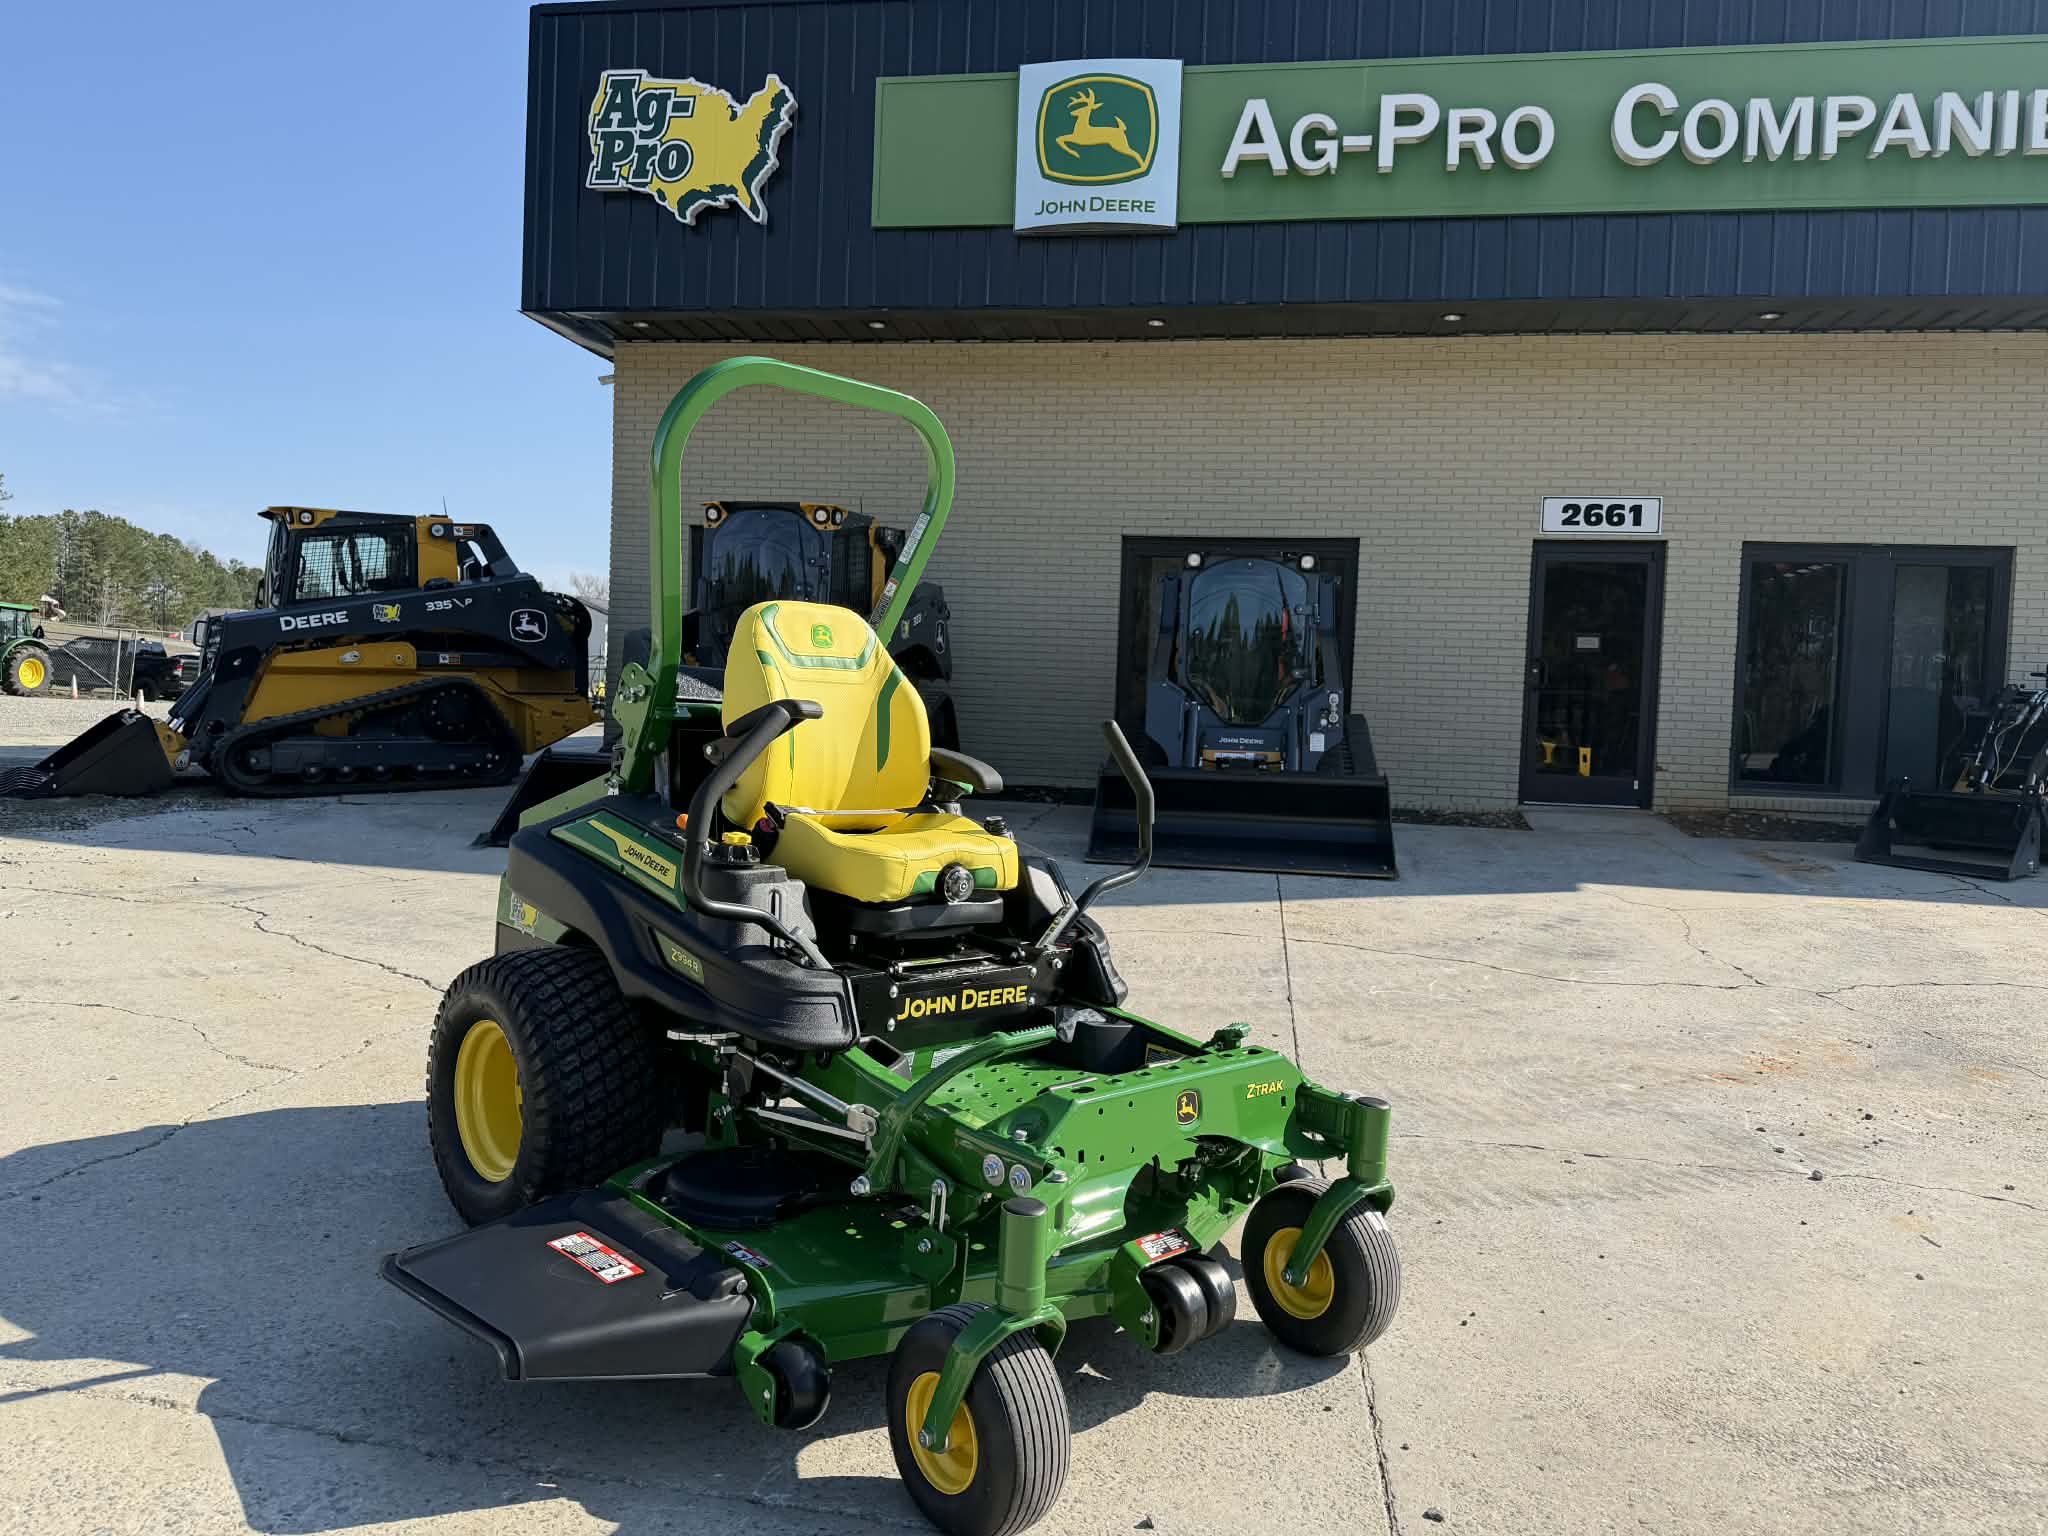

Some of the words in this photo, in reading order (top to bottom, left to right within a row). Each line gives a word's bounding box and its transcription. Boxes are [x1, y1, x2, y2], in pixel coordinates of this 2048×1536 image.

[594, 75, 695, 141] Ag-
[591, 130, 693, 184] Pro
[1034, 199, 1086, 216] JOHN
[1089, 196, 1156, 213] DEERE
[1561, 503, 1643, 527] 2661
[425, 599, 453, 611] 335
[280, 610, 349, 632] DEERE
[624, 844, 645, 864] JOHN
[644, 855, 670, 877] DEERE
[896, 994, 957, 1021] JOHN
[961, 985, 1028, 1011] DEERE
[1246, 1080, 1284, 1099] ZTRAK
